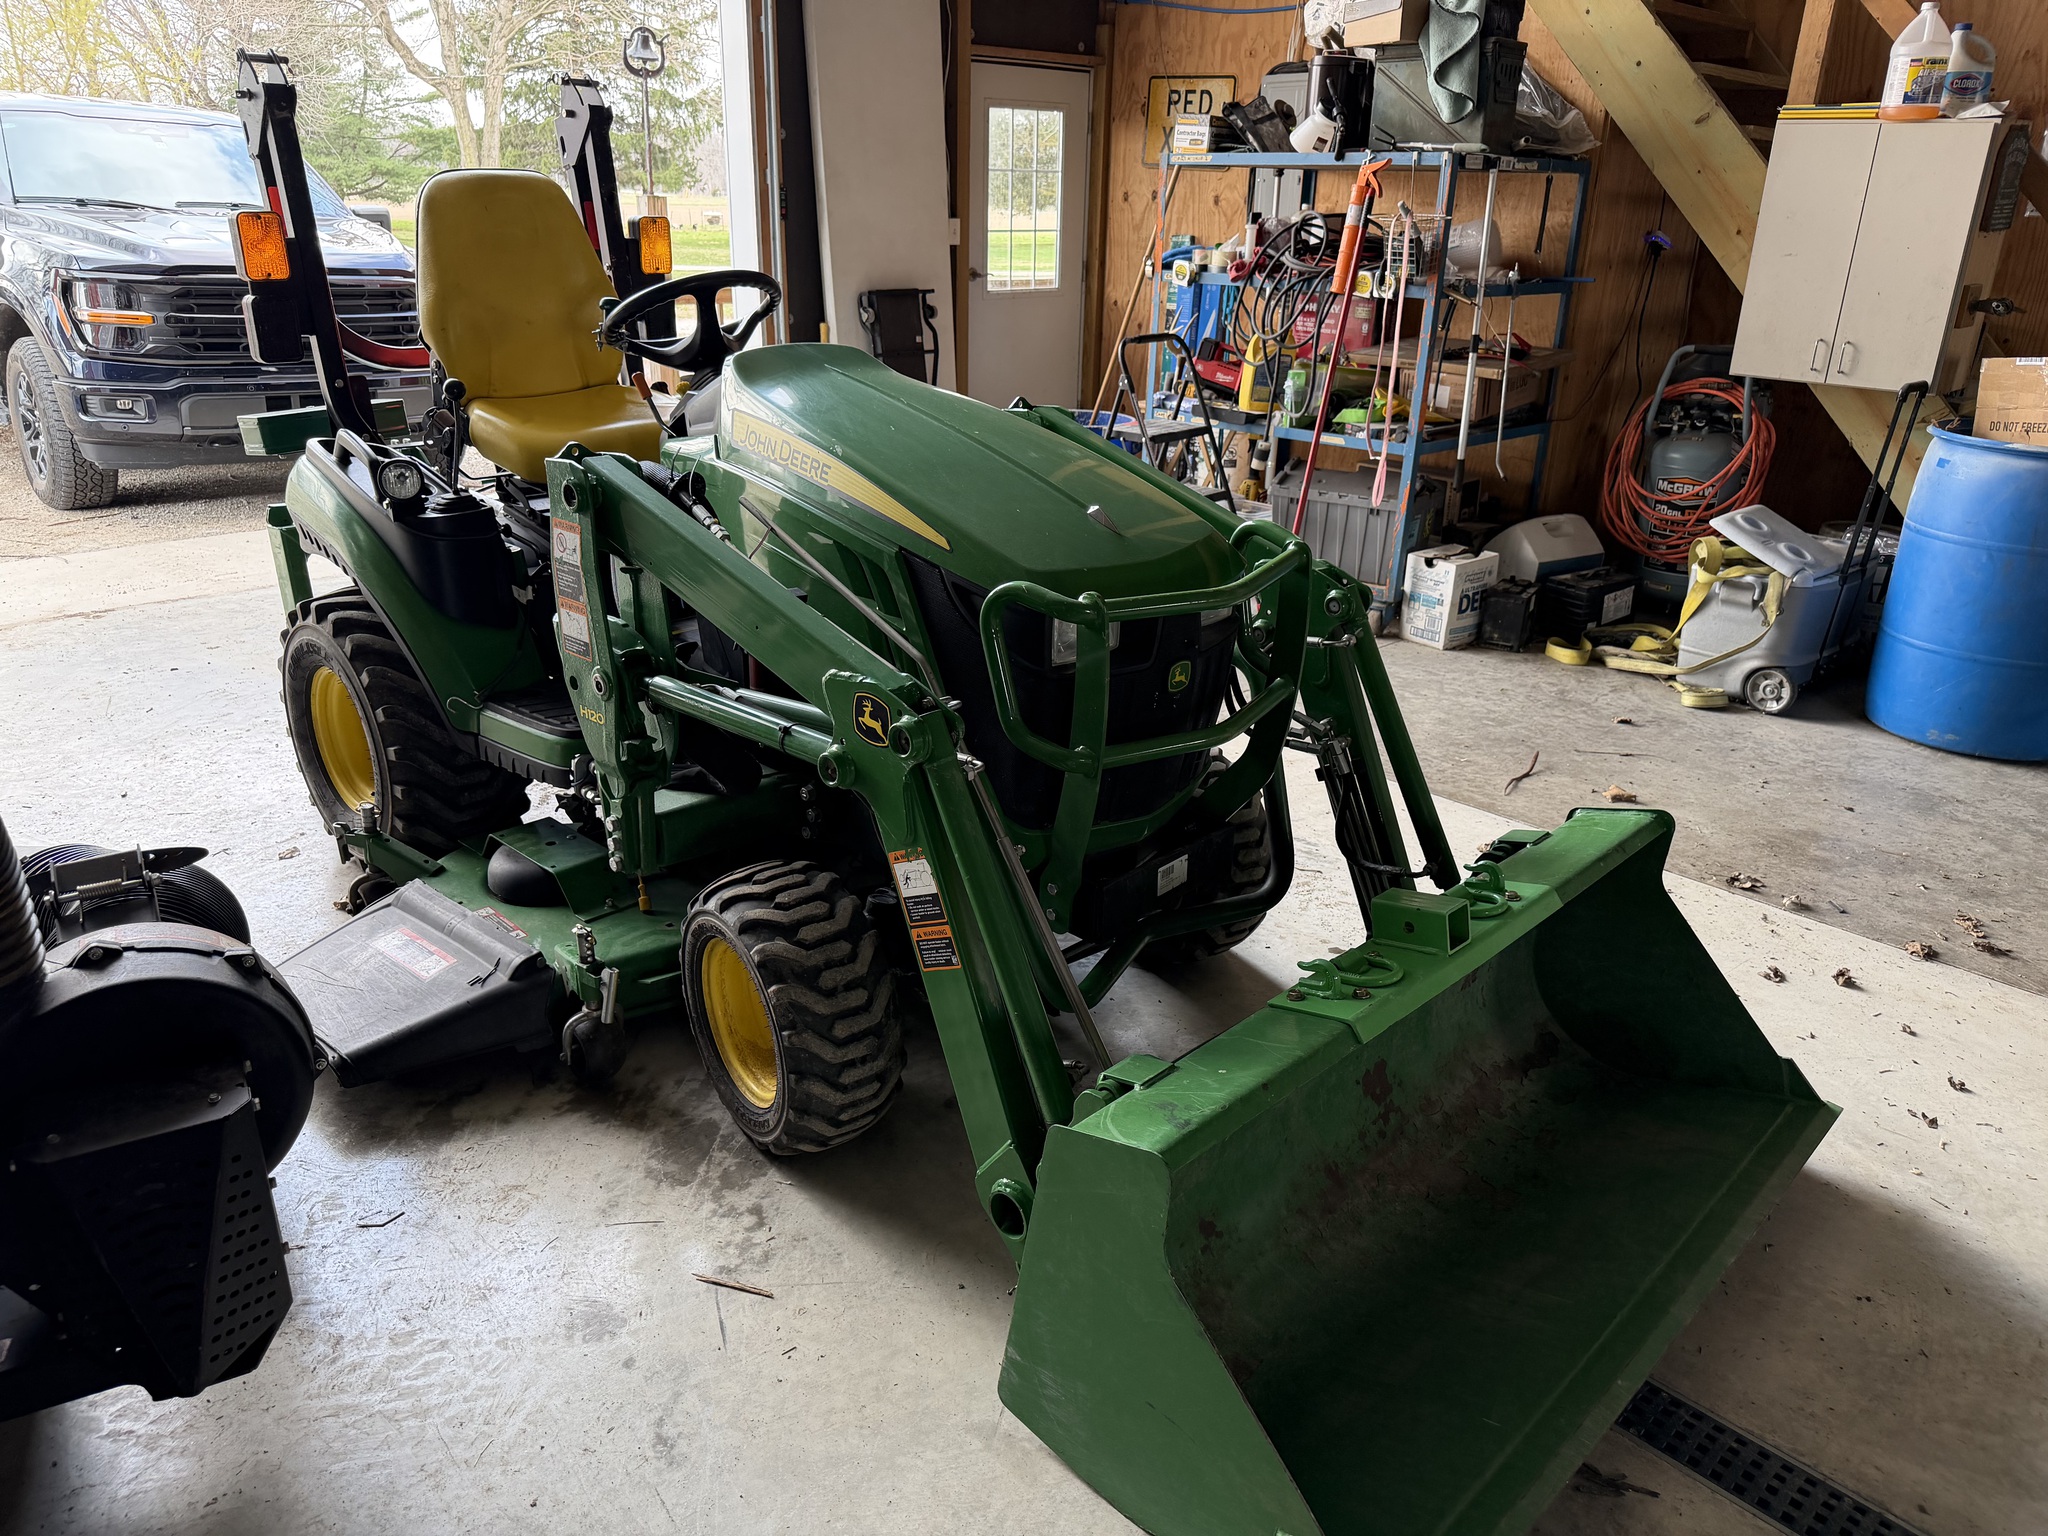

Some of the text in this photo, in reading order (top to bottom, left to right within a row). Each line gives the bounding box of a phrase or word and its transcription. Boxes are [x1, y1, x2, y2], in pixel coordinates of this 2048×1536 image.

[1952, 79, 1981, 88] CLOROX
[1167, 89, 1213, 117] PED
[1989, 421, 2048, 433] DO NOT FREEZ
[740, 424, 832, 483] JOHN DEERE
[579, 704, 605, 725] H120
[923, 929, 948, 938] WARNING
